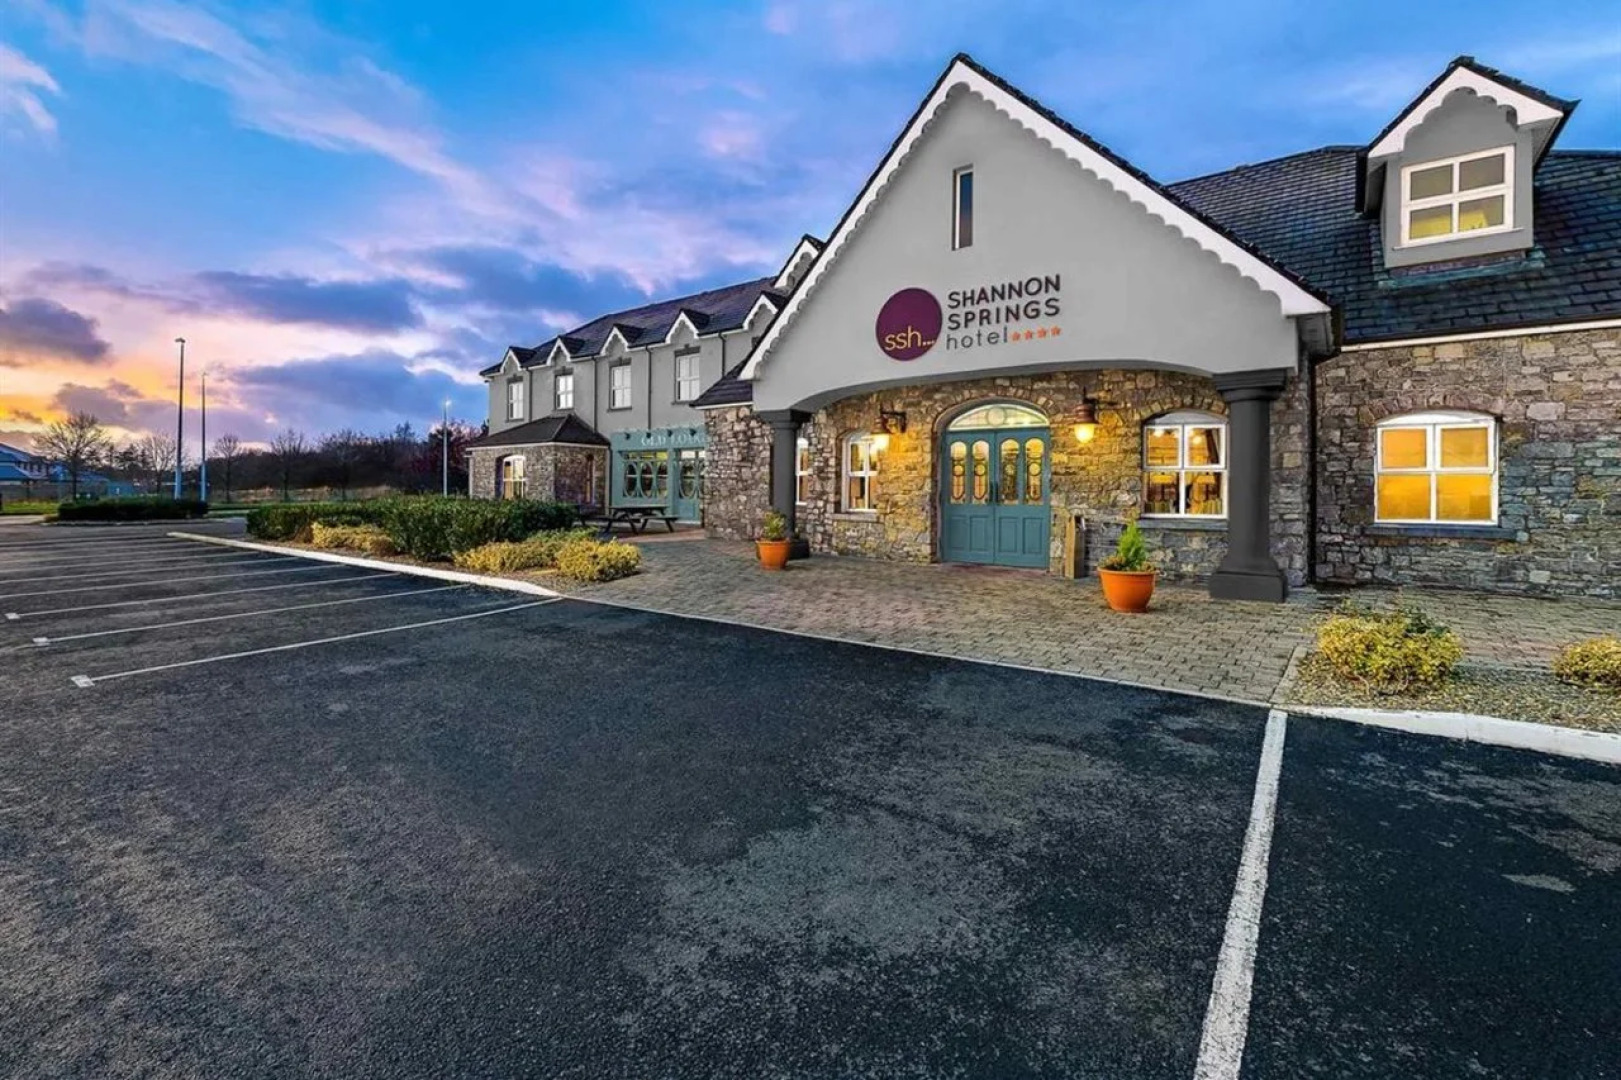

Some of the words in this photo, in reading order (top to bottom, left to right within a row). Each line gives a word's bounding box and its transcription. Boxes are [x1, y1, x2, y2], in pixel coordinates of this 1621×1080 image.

[947, 273, 1061, 309] SHANNON
[947, 297, 1060, 331] SPRINGS
[946, 326, 1008, 350] hotel
